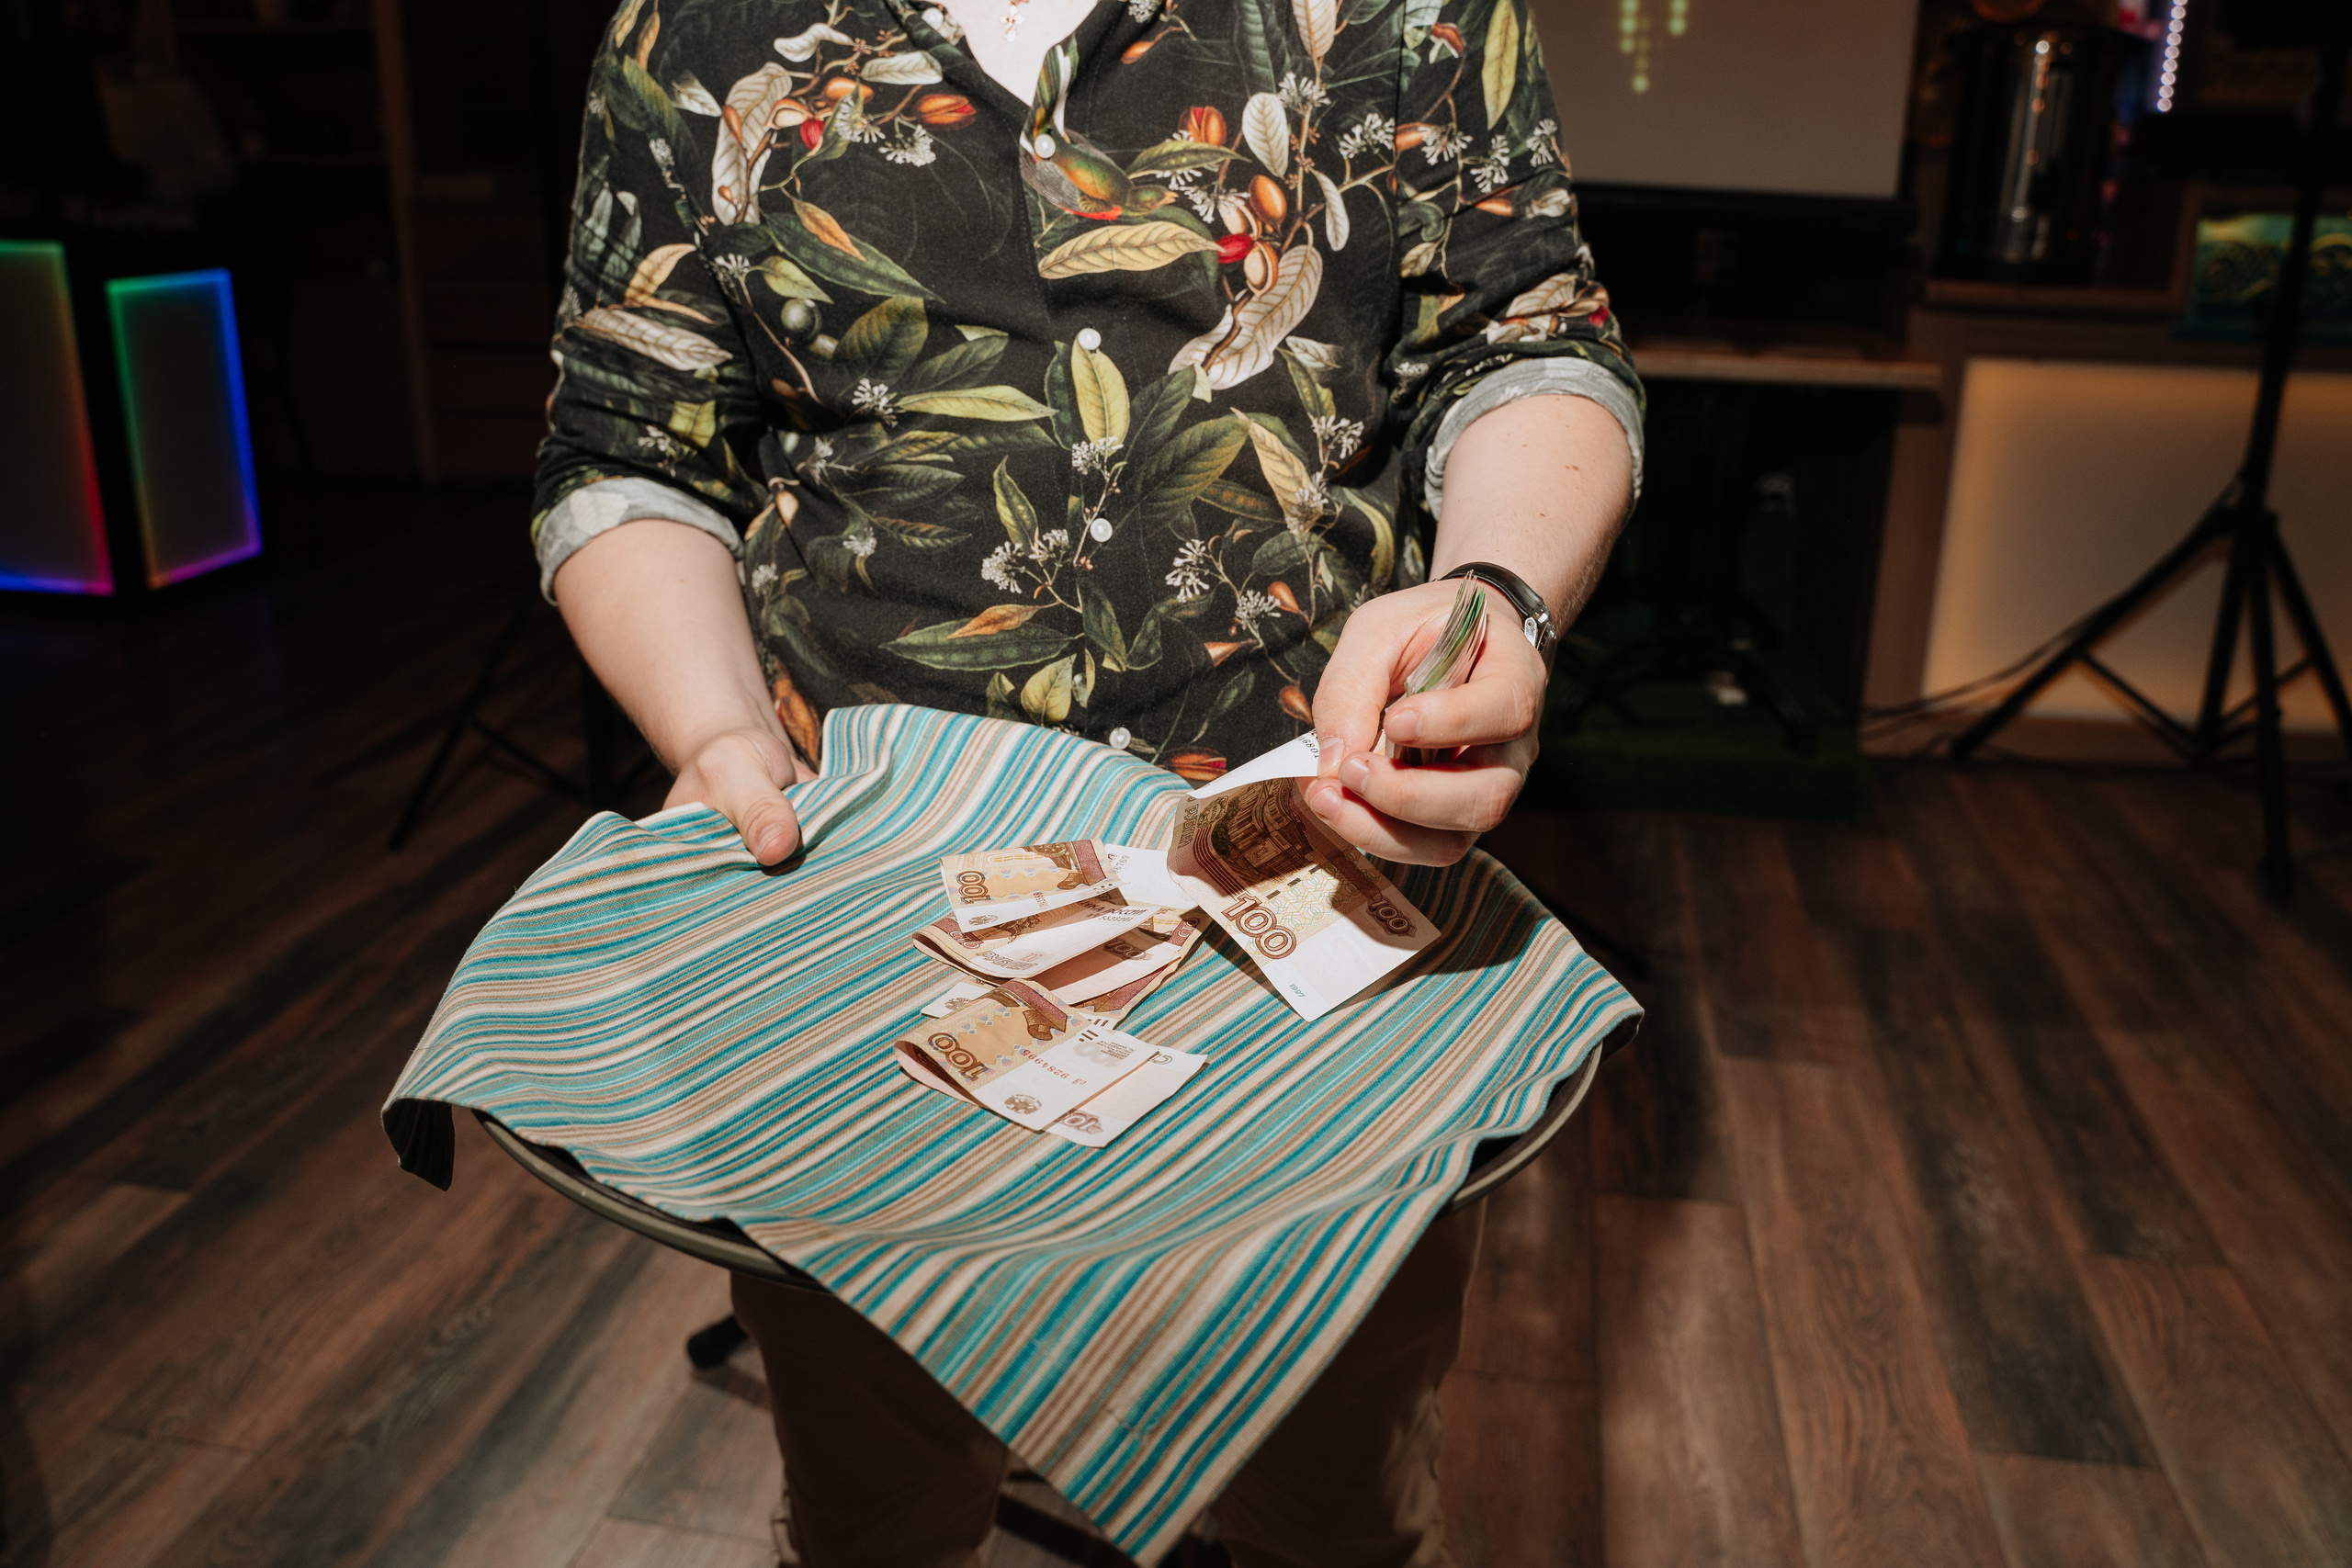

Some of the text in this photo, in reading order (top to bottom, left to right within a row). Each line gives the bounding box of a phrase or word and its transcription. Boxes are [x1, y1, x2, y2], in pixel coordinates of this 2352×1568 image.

[956, 870, 991, 905] 100
[1221, 892, 1297, 960] 100
[1368, 895, 1412, 936] 100
[1103, 938, 1147, 959] 100
[1289, 983, 1306, 998] 1997
[927, 1032, 989, 1081] 100
[1061, 1111, 1100, 1134] 10
